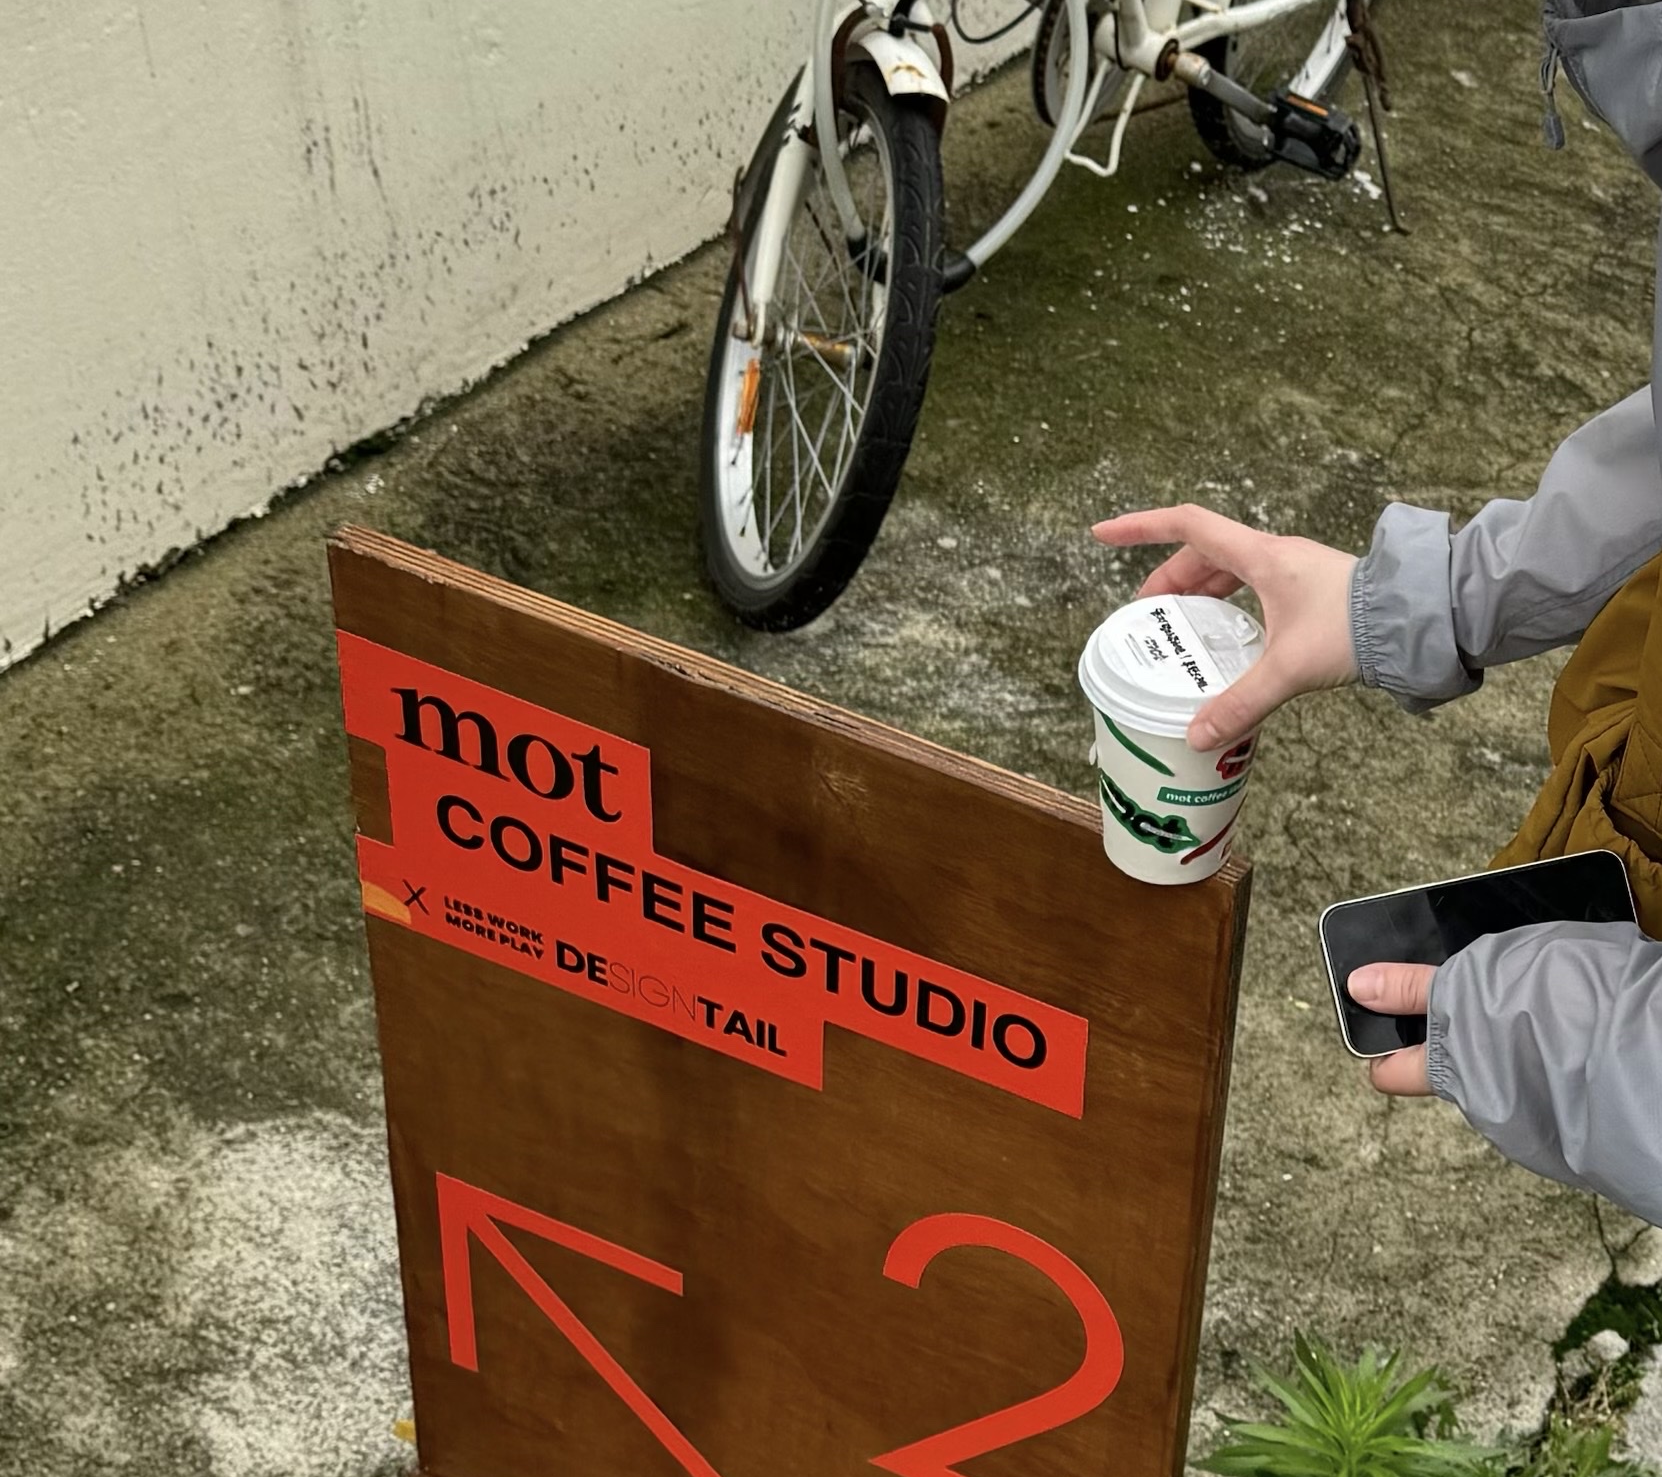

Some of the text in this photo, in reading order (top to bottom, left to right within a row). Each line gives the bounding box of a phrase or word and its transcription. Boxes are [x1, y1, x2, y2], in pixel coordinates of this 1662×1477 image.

[391, 688, 622, 823] mot
[1166, 793, 1191, 803] mot
[436, 795, 1047, 1070] COFFEE STUDIO
[444, 895, 543, 945] LESS WORK
[445, 912, 544, 960] MORE PLAY
[555, 940, 787, 1058] DESIGNTAIL
